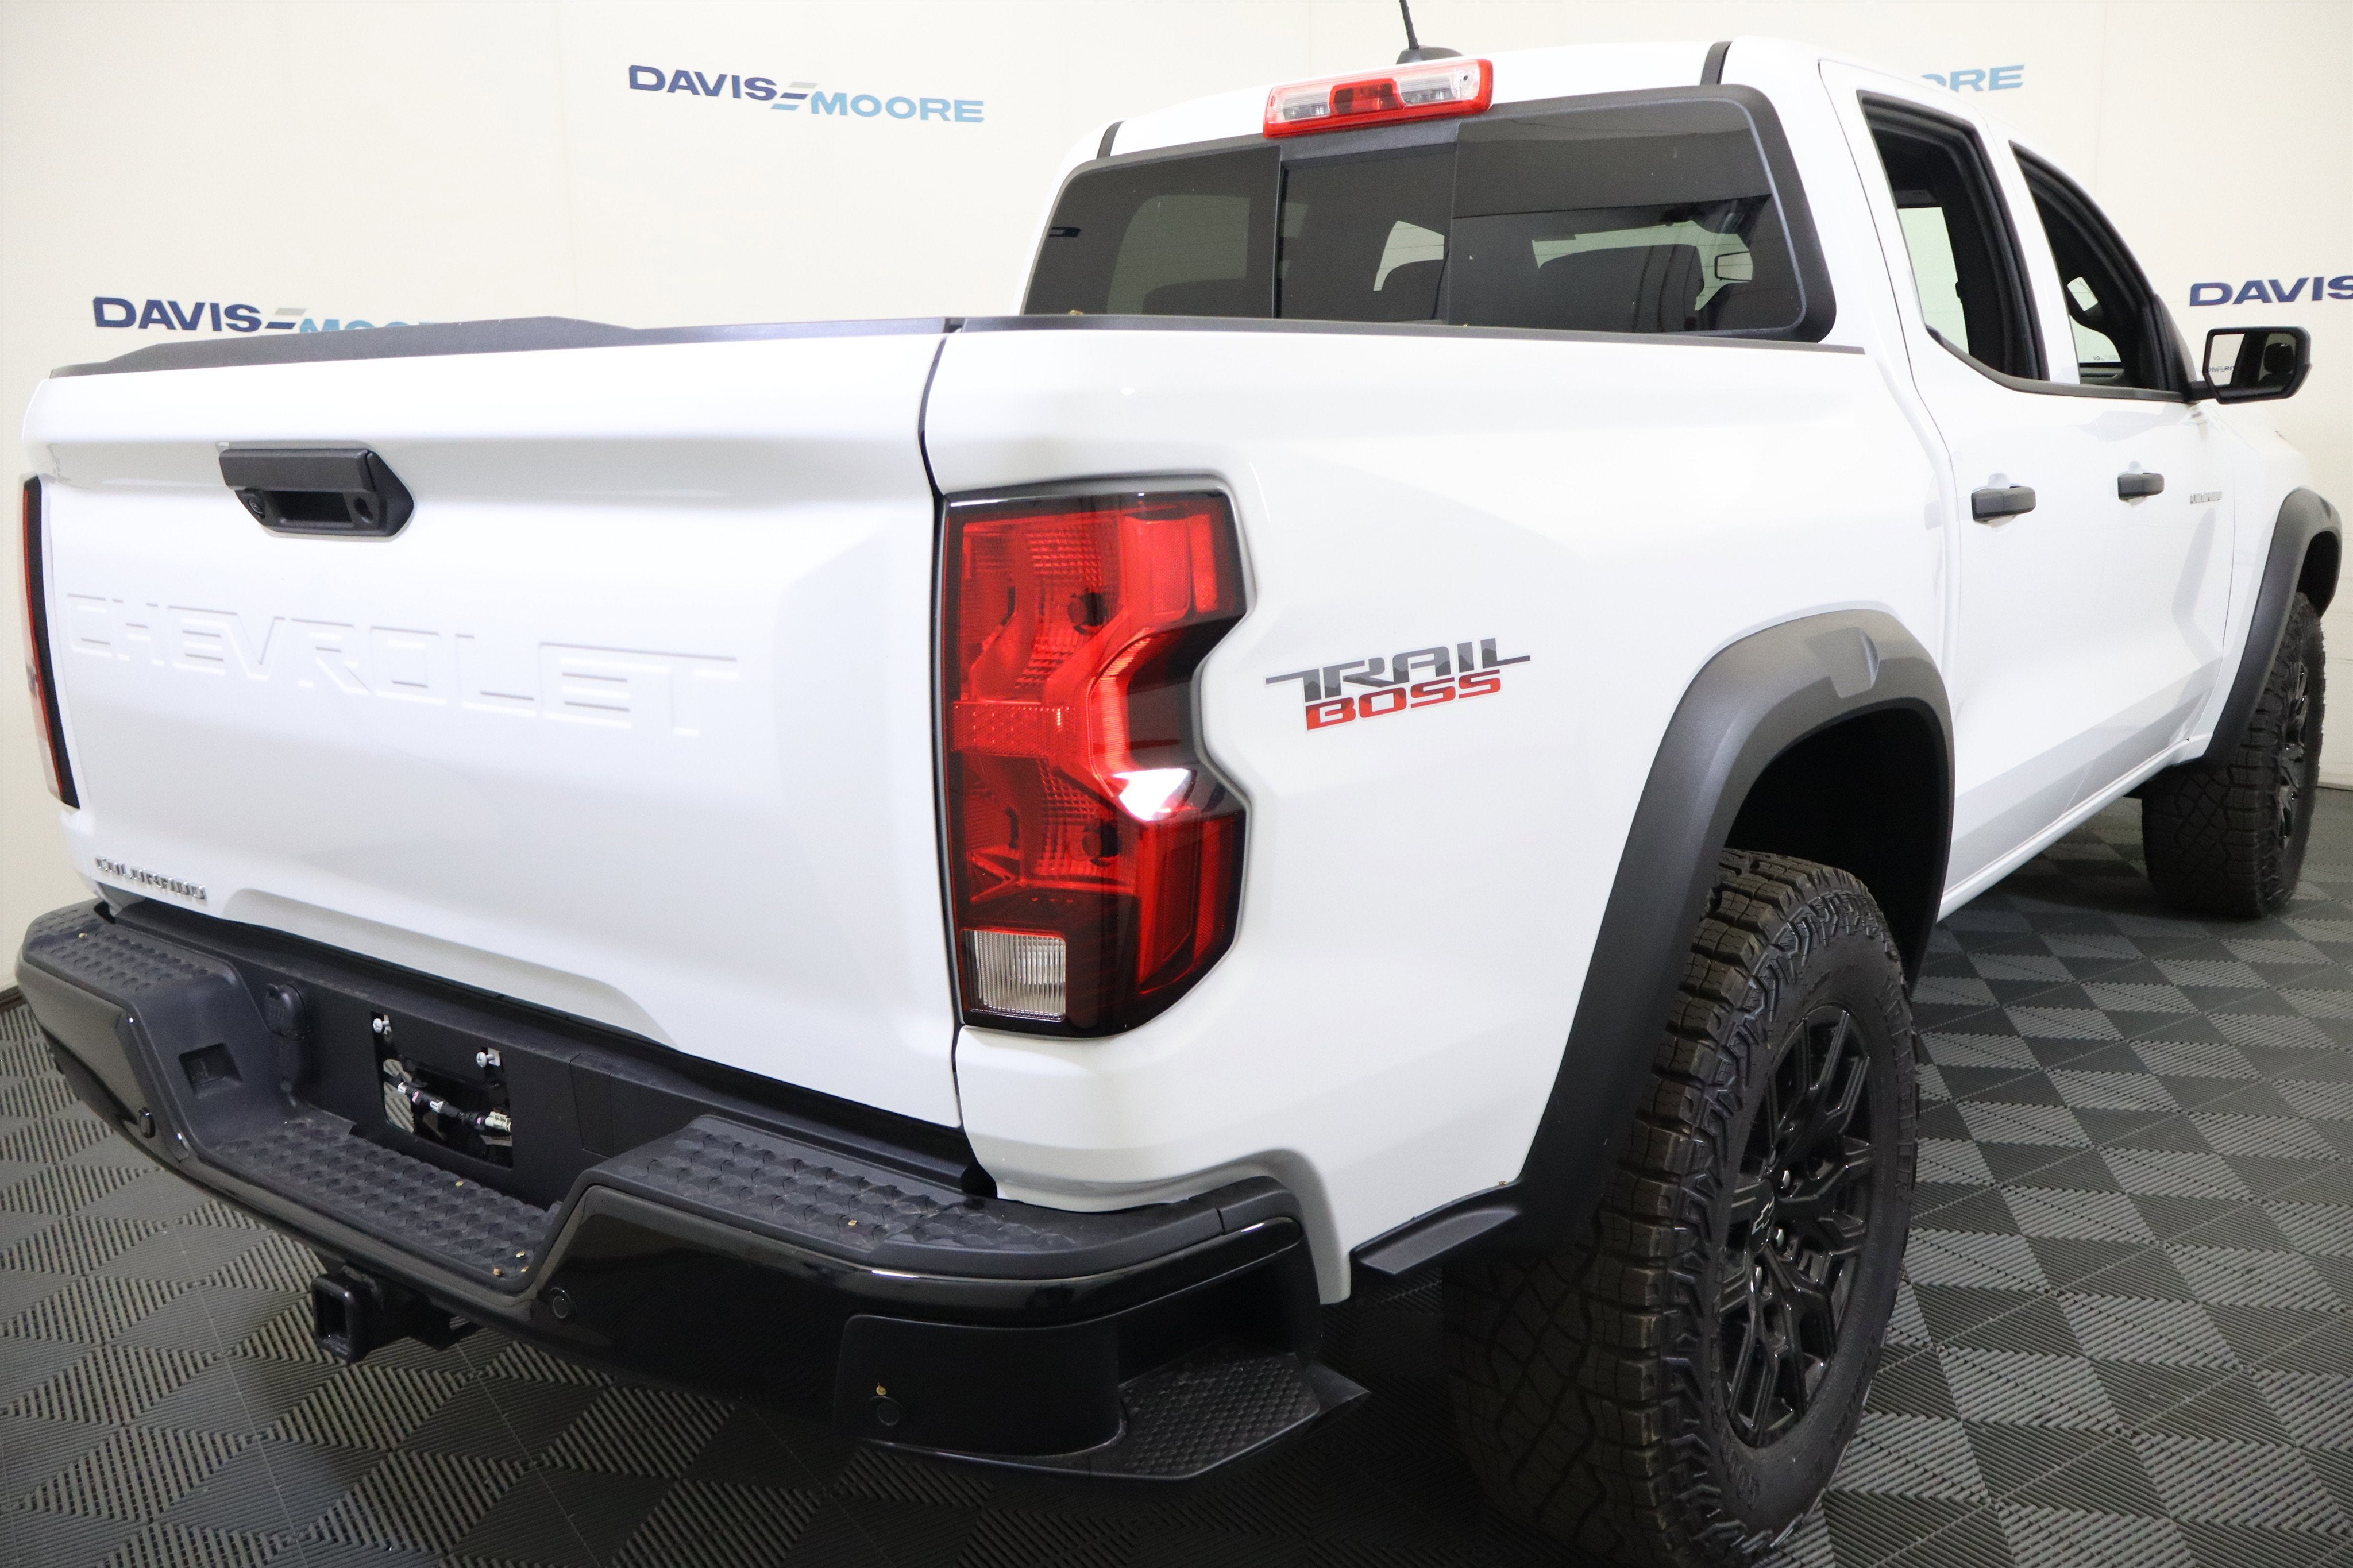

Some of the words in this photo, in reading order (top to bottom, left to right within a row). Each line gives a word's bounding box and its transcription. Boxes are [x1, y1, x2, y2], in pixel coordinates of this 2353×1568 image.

[628, 65, 777, 101] DAVIS
[811, 91, 985, 123] MOORE
[92, 296, 262, 333] DAVIS
[2189, 275, 2353, 307] DAVIS
[66, 593, 739, 737] CHEVROLET
[1265, 638, 1531, 702] TRAIL
[1305, 669, 1502, 731] BOSS
